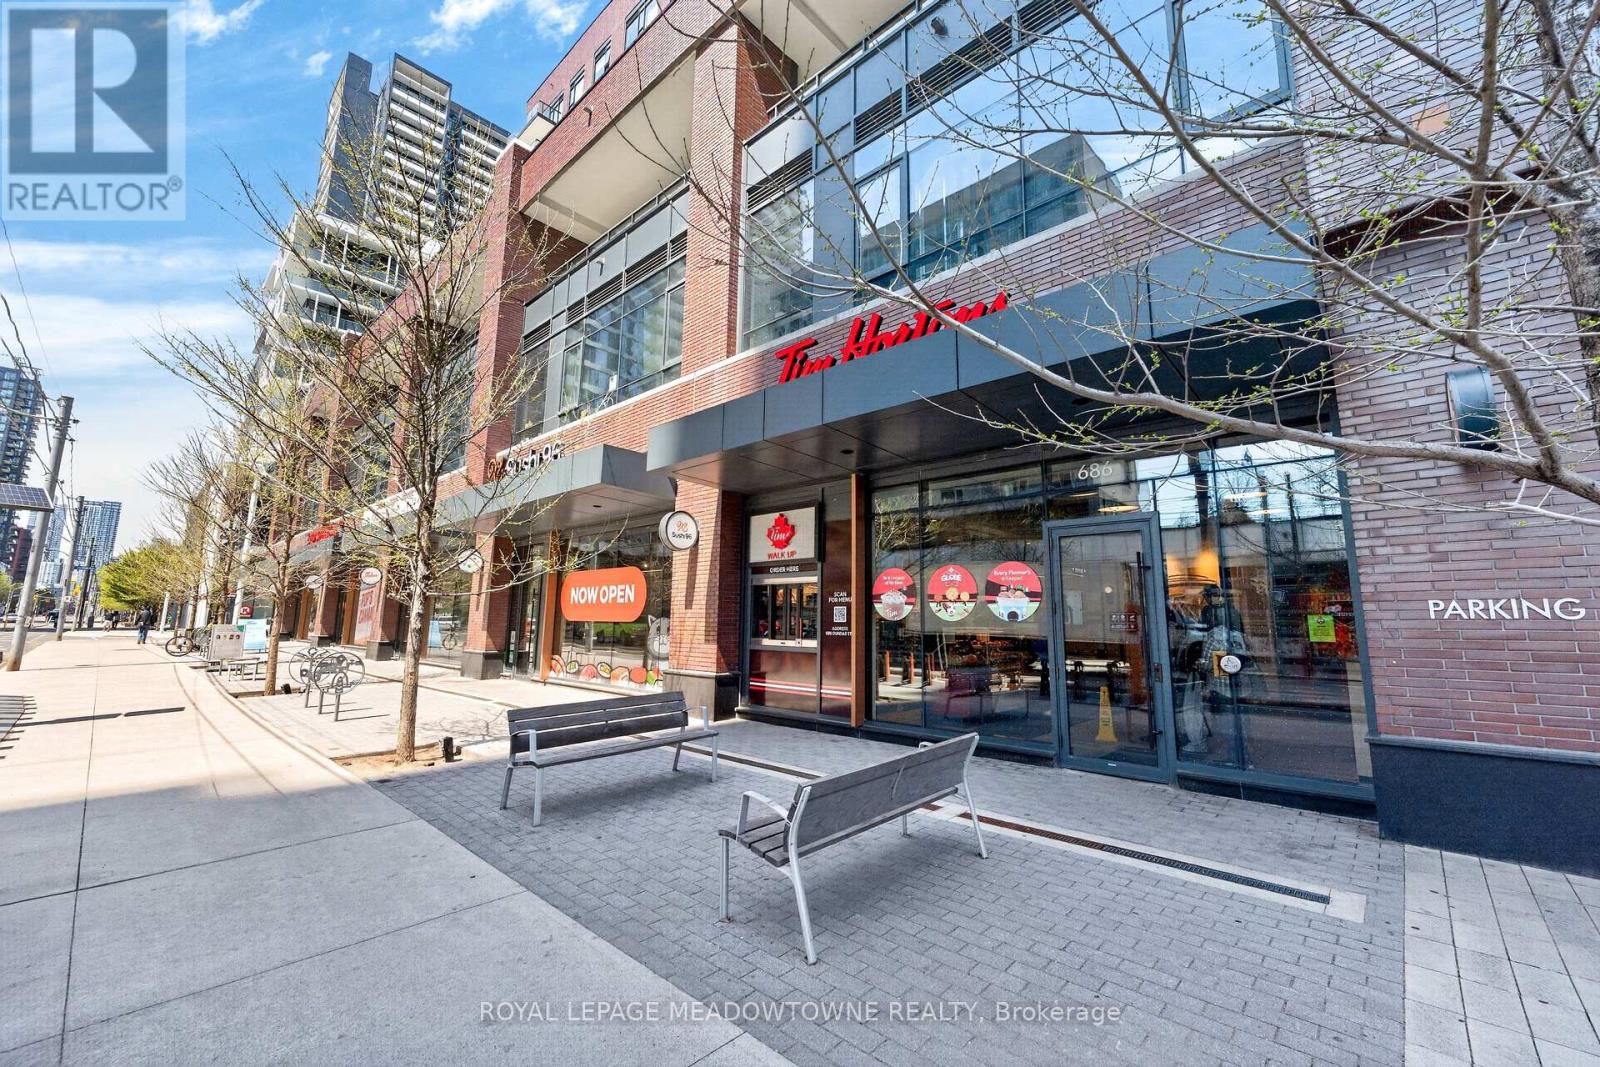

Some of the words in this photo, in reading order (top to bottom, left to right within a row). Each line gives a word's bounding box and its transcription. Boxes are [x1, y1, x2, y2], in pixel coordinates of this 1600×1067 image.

[775, 337, 836, 384] Tim
[839, 289, 1011, 365] Hortons
[1078, 461, 1112, 480] 686
[768, 551, 785, 560] WALK
[787, 550, 797, 559] UP
[570, 586, 598, 605] NOW
[600, 584, 635, 604] OPEN
[1428, 597, 1586, 621] PARKING
